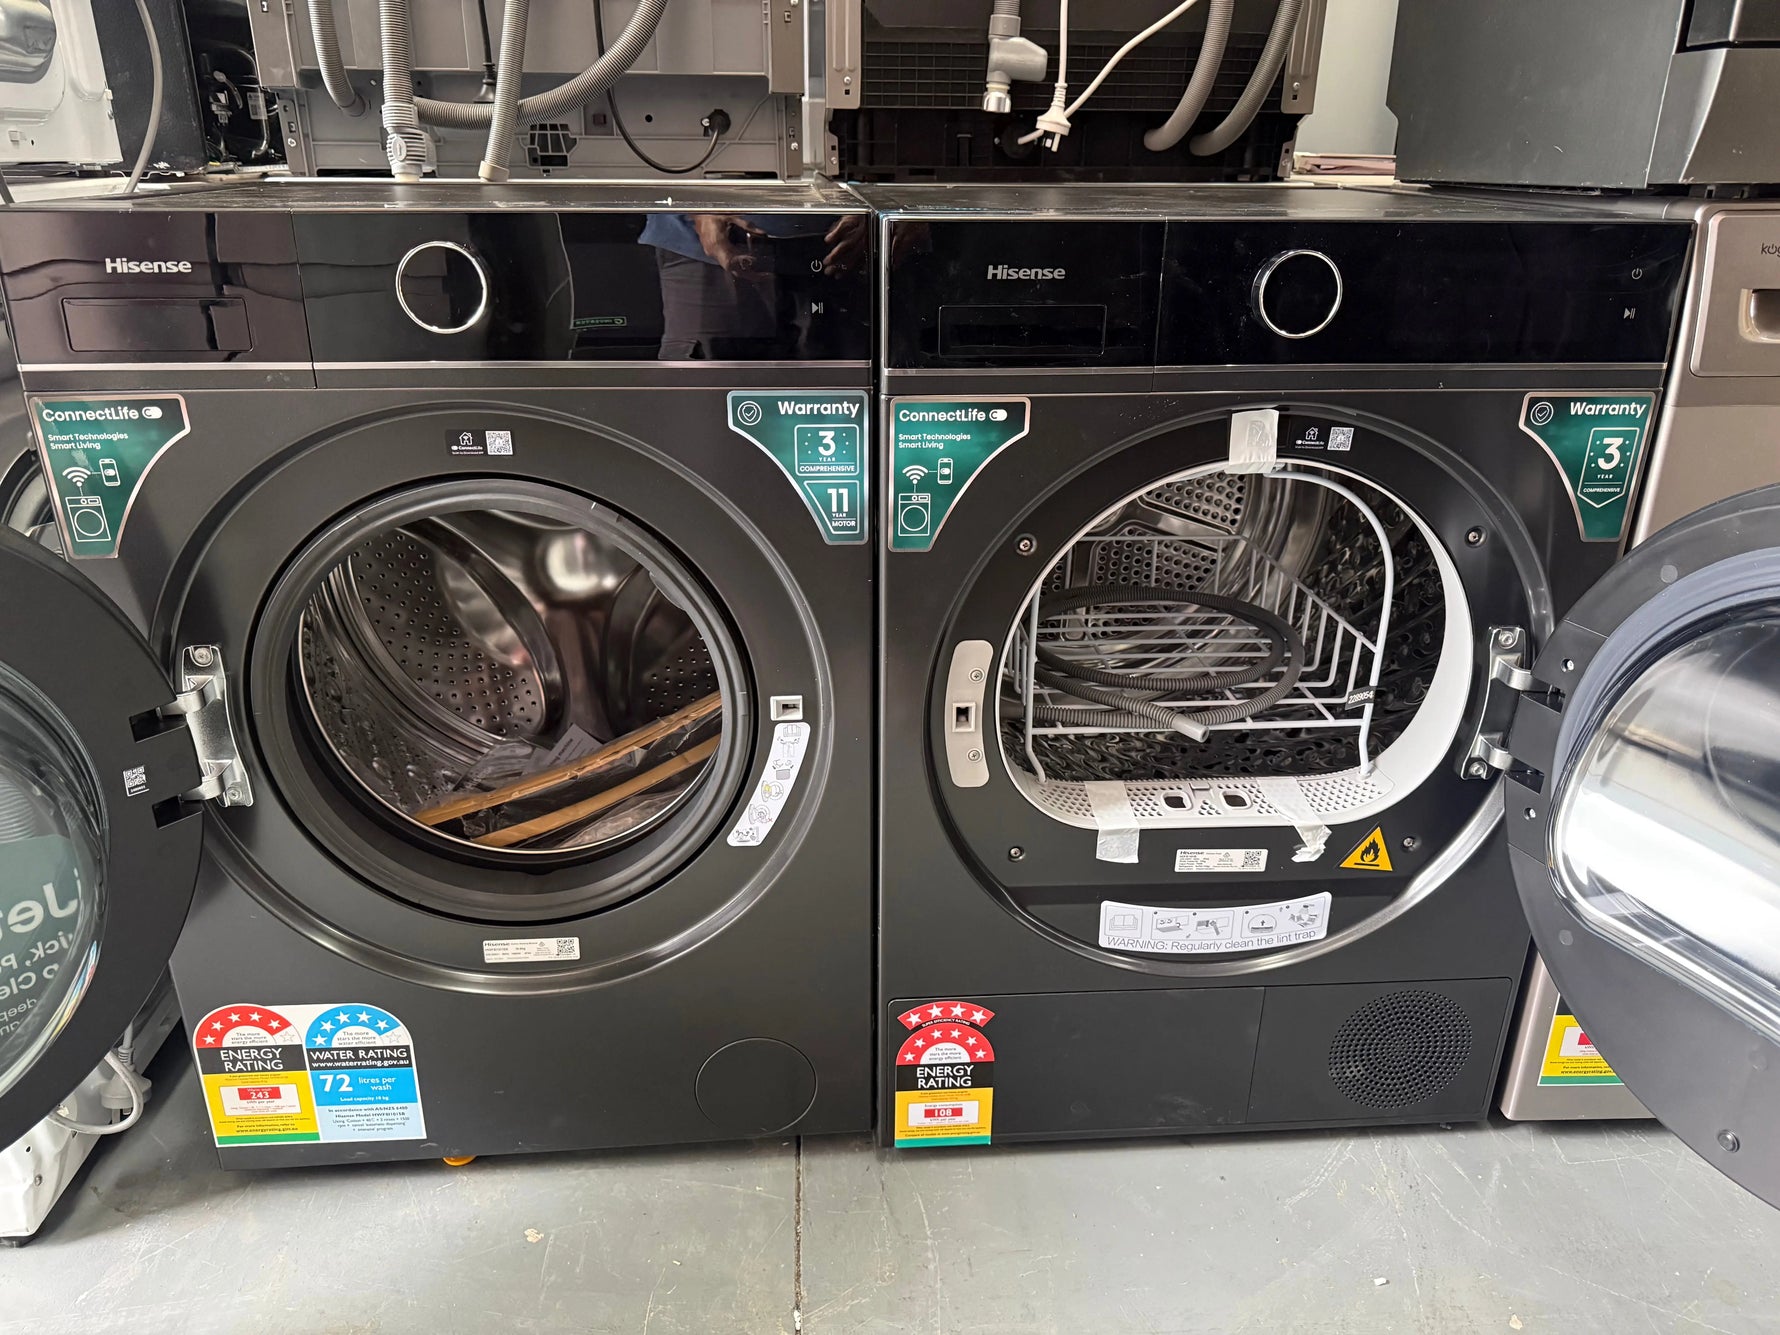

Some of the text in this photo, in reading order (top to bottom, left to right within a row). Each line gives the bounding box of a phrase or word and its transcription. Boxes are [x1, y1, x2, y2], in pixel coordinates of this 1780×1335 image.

[105, 257, 192, 274] Hisense
[986, 264, 1066, 280] Hisense
[42, 406, 140, 422] ConnectLife
[777, 401, 860, 418] Warranty
[899, 409, 986, 422] ConnectLife
[1570, 402, 1647, 418] Warranty
[48, 432, 129, 442] Smart Technologies
[817, 430, 836, 456] 3
[922, 432, 971, 442] Technologies
[50, 442, 101, 450] Smart Living
[922, 441, 944, 450] Living
[1597, 437, 1624, 470] 3
[827, 488, 849, 512] 11
[1107, 929, 1316, 952] WARNING: Regularly clean the lint trap
[220, 1048, 282, 1061] ENERGY
[310, 1048, 408, 1060] WATER RATING
[224, 1059, 284, 1072] RATING
[312, 1060, 410, 1068] www.waterrating.gov.au
[916, 1064, 974, 1078] ENERGY
[319, 1074, 354, 1092] 72
[917, 1076, 972, 1089] RATING
[250, 1092, 270, 1100] 243
[934, 1108, 952, 1116] 108
